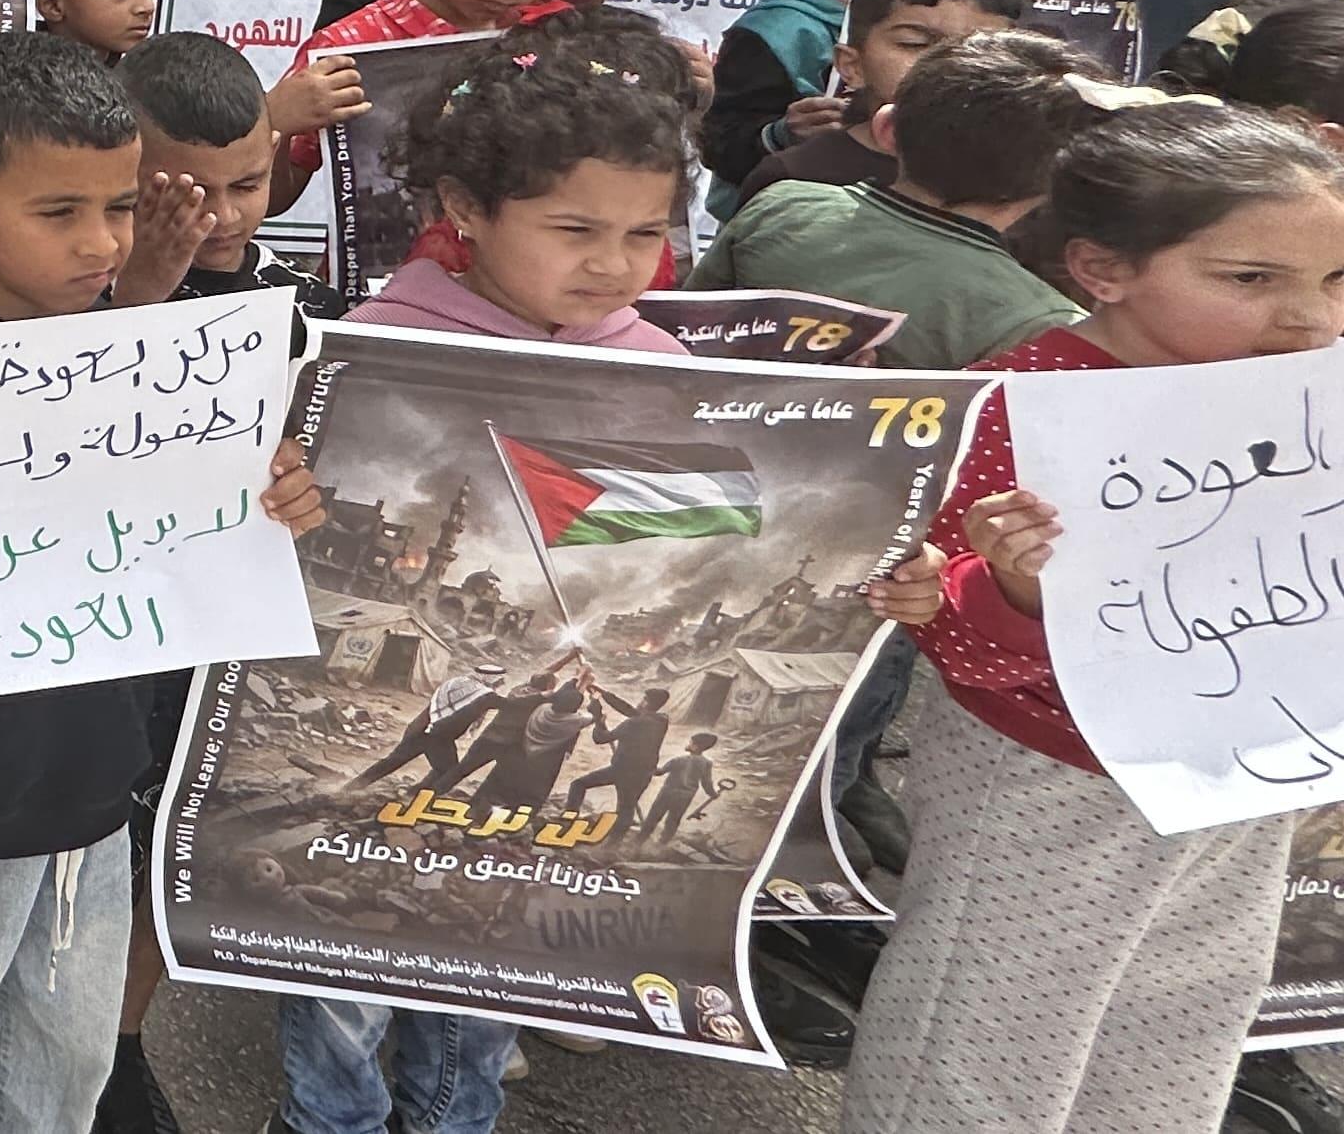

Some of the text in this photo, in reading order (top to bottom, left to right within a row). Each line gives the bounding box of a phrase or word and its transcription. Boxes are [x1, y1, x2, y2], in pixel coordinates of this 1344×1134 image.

[0, 2, 13, 17] of
[1113, 1, 1138, 31] 78
[340, 167, 353, 202] Your
[343, 206, 356, 245] Than
[344, 247, 359, 298] Deeper
[676, 325, 722, 346] النكبة
[724, 323, 749, 343] على
[782, 316, 853, 353] 78
[150, 304, 264, 396] مركز
[693, 400, 764, 425] النكبة
[763, 401, 807, 426] على
[867, 396, 947, 448] 78
[1101, 386, 1330, 550] العودة
[904, 463, 934, 520] Years
[182, 487, 249, 542] لا
[87, 508, 178, 573] بديل
[892, 524, 913, 543] of
[175, 660, 242, 903] We Will Not Leave; Our Roo
[376, 788, 619, 848] لن نرحل
[307, 832, 641, 901] جذورنا أعمق من دماركم
[1282, 874, 1330, 902] دمار
[210, 924, 237, 942] النكبة
[537, 904, 677, 951] UNRWA
[213, 949, 234, 962] PLO
[318, 939, 354, 960] الوطنية
[354, 944, 384, 963] اللجنة
[432, 956, 464, 975] شؤون
[464, 960, 489, 978] دائرة
[496, 963, 555, 987] الفلسطينية
[556, 975, 591, 993] التحرير
[591, 979, 628, 997] منظمة
